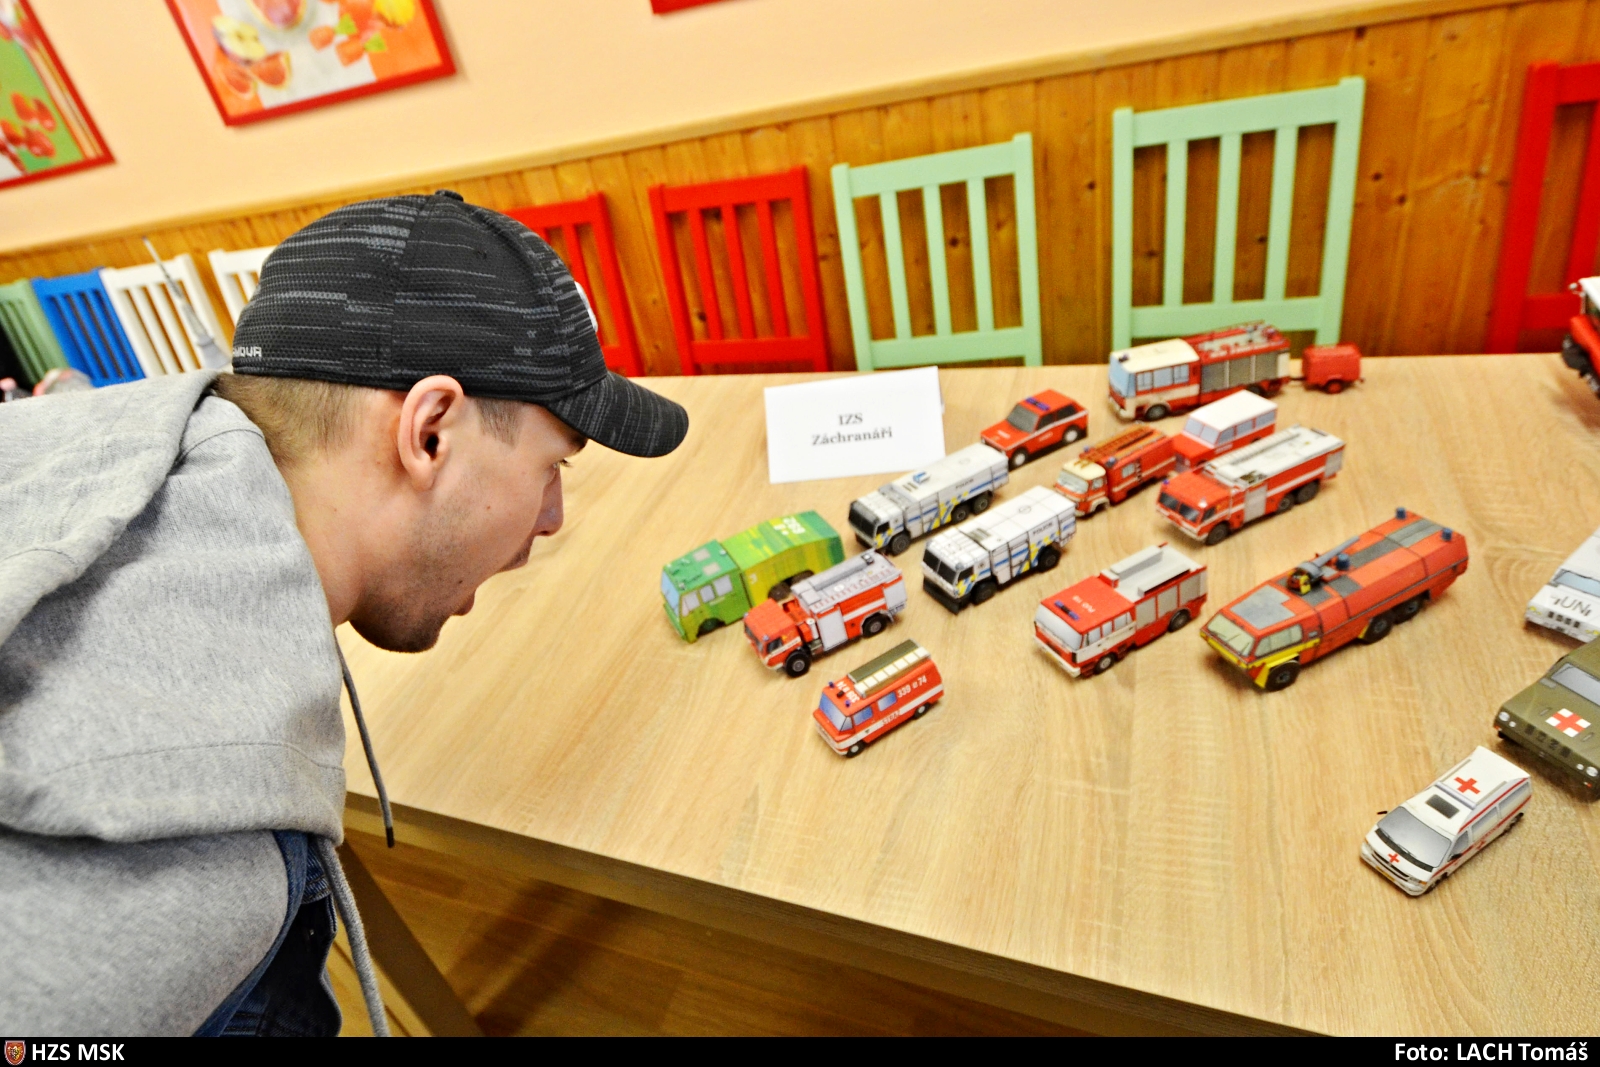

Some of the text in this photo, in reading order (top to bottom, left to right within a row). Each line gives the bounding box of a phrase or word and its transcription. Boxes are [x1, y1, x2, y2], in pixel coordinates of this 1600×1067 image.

[838, 412, 863, 426] IZS
[811, 426, 893, 446] Záchranáři
[897, 685, 911, 698] 339
[918, 675, 927, 686] 74
